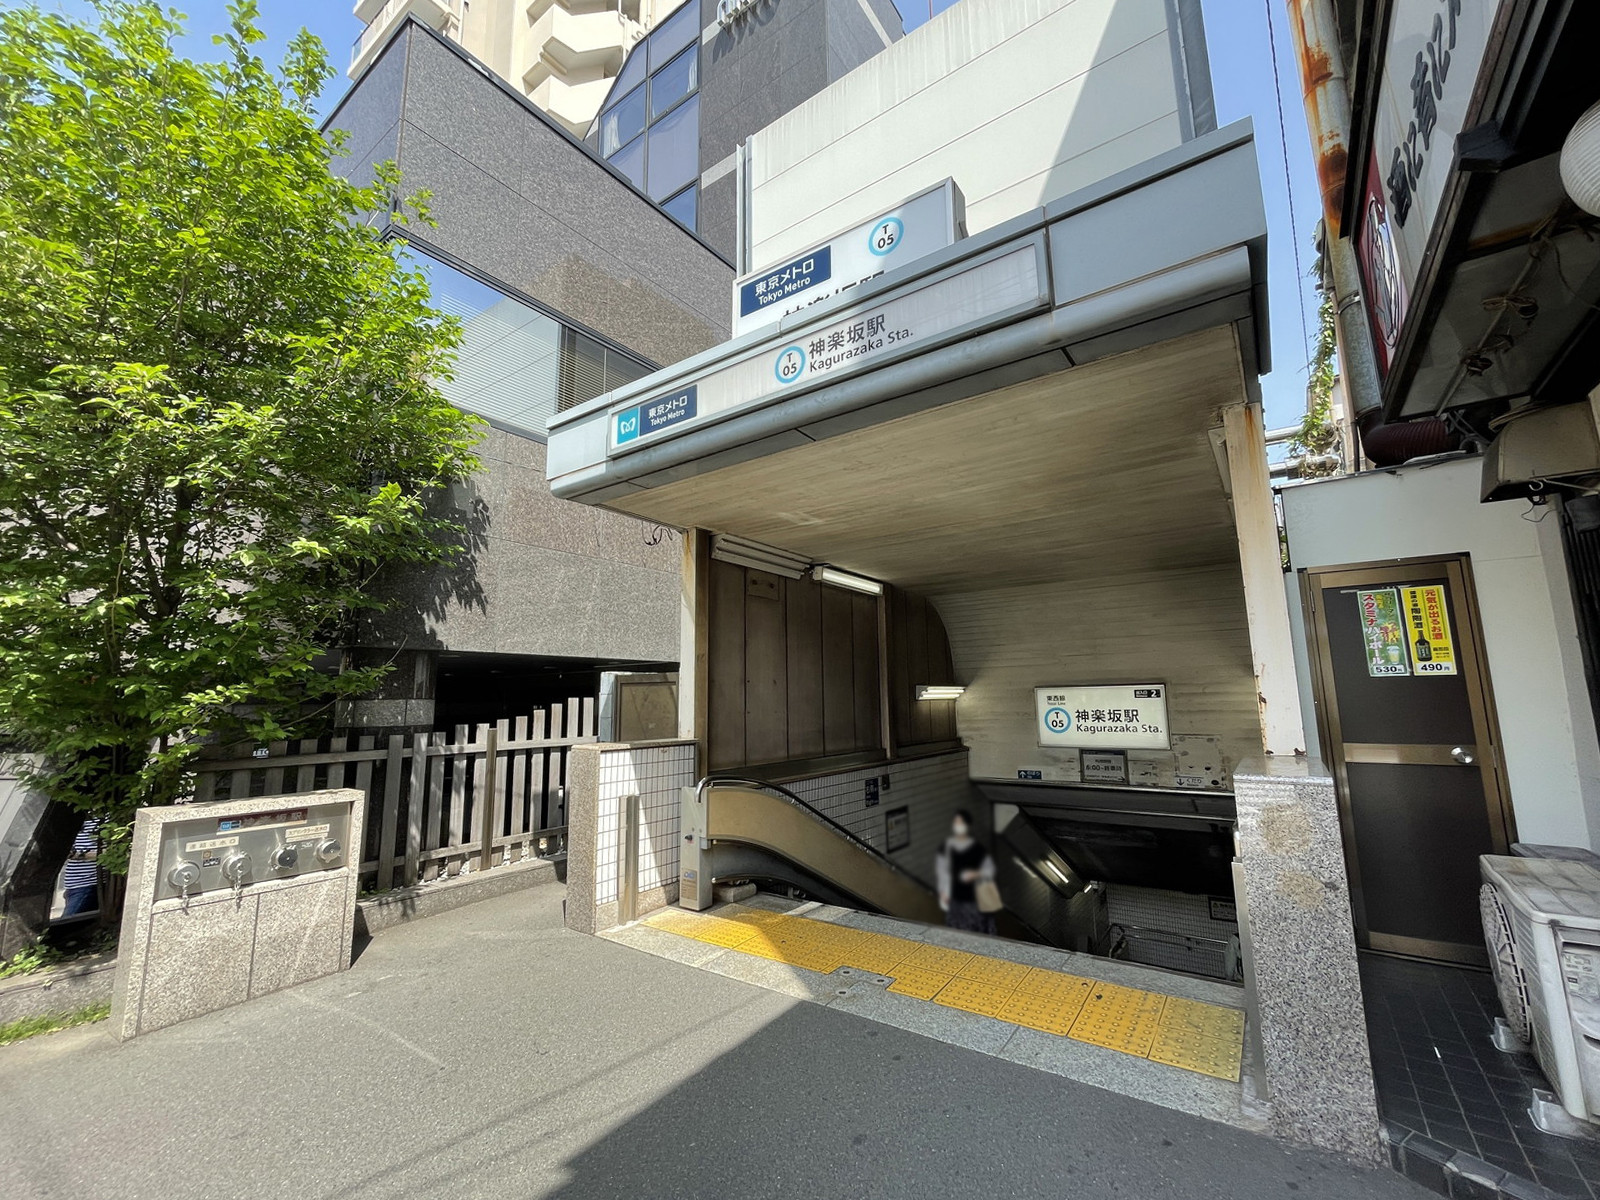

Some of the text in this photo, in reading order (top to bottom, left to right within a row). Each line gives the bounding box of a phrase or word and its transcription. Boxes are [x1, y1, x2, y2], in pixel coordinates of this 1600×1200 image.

[881, 223, 890, 236] T
[877, 233, 895, 249] 05
[754, 258, 815, 296] 東京メトロ
[757, 285, 784, 306] Tokyo
[784, 276, 811, 296] Metro
[809, 313, 886, 360] 神楽坂駅
[786, 353, 794, 363] T
[809, 328, 914, 373] Kagurazaka Sta.
[782, 362, 798, 377] 05
[647, 394, 688, 419] 東京メトロ
[650, 408, 686, 428] Tokyo Metro
[1424, 589, 1443, 640] 元気が出るお酒
[1420, 663, 1451, 672] 490円
[1150, 689, 1158, 698] 2
[1051, 719, 1065, 728] 05
[1075, 709, 1140, 724] 神楽坂駅
[1076, 723, 1163, 735] Kagurazaka Sta.
